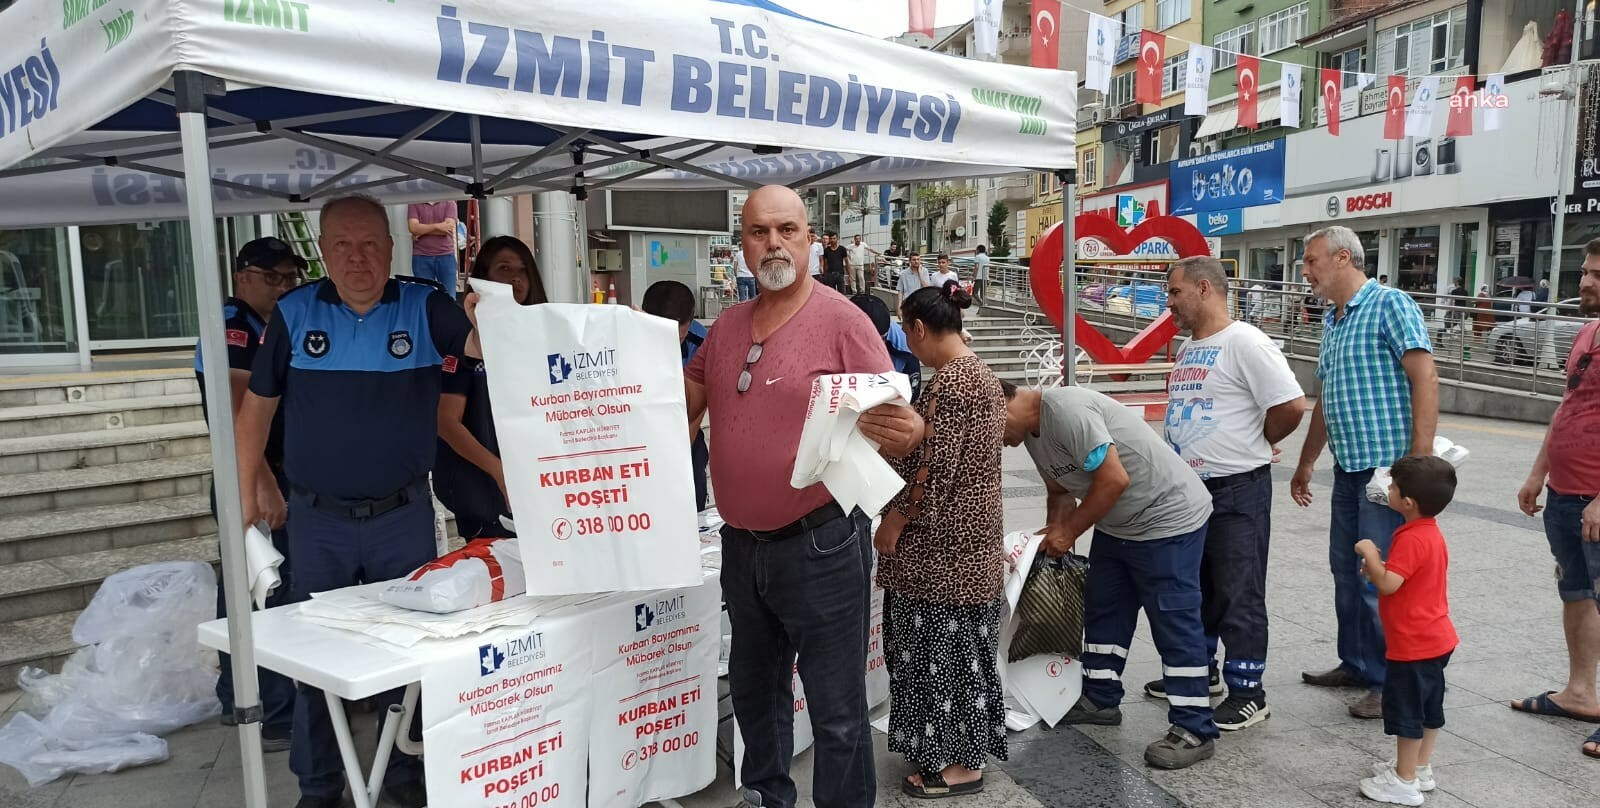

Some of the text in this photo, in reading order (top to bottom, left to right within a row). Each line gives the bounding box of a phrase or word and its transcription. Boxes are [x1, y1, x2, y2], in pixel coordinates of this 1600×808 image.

[710, 17, 780, 61] T.C.
[436, 5, 961, 143] İZMİT BELEDİYESİ
[0, 37, 60, 139] YESİ
[972, 88, 1009, 111] SANAT
[1192, 164, 1253, 201] beko
[1346, 192, 1392, 213] BOSCH
[1208, 212, 1229, 226] beko
[573, 347, 615, 369] İZMİT
[530, 384, 642, 407] Kurban Bayramımız
[1181, 383, 1203, 391] CLUB
[545, 403, 631, 423] Mübarek Olsun
[539, 458, 650, 487] KURBAN ETİ
[565, 484, 628, 508] POŞETİ
[577, 512, 651, 535] 318 00 00
[655, 594, 685, 616] İZMİT
[506, 631, 544, 657] İZMİT
[618, 623, 700, 655] Kurban Bayramımız
[626, 640, 693, 667] Mübarek Olsun
[459, 663, 563, 703] Kurban Bayramımız
[470, 683, 554, 716] Mübarek Olsun
[618, 685, 701, 726] KURBAN ETİ
[636, 711, 686, 739] POŞETİ
[662, 736, 681, 752] 00
[684, 731, 699, 748] 00
[461, 731, 563, 784] KURBAN ETİ
[485, 760, 544, 798] POŞETİ
[542, 783, 560, 802] 00
